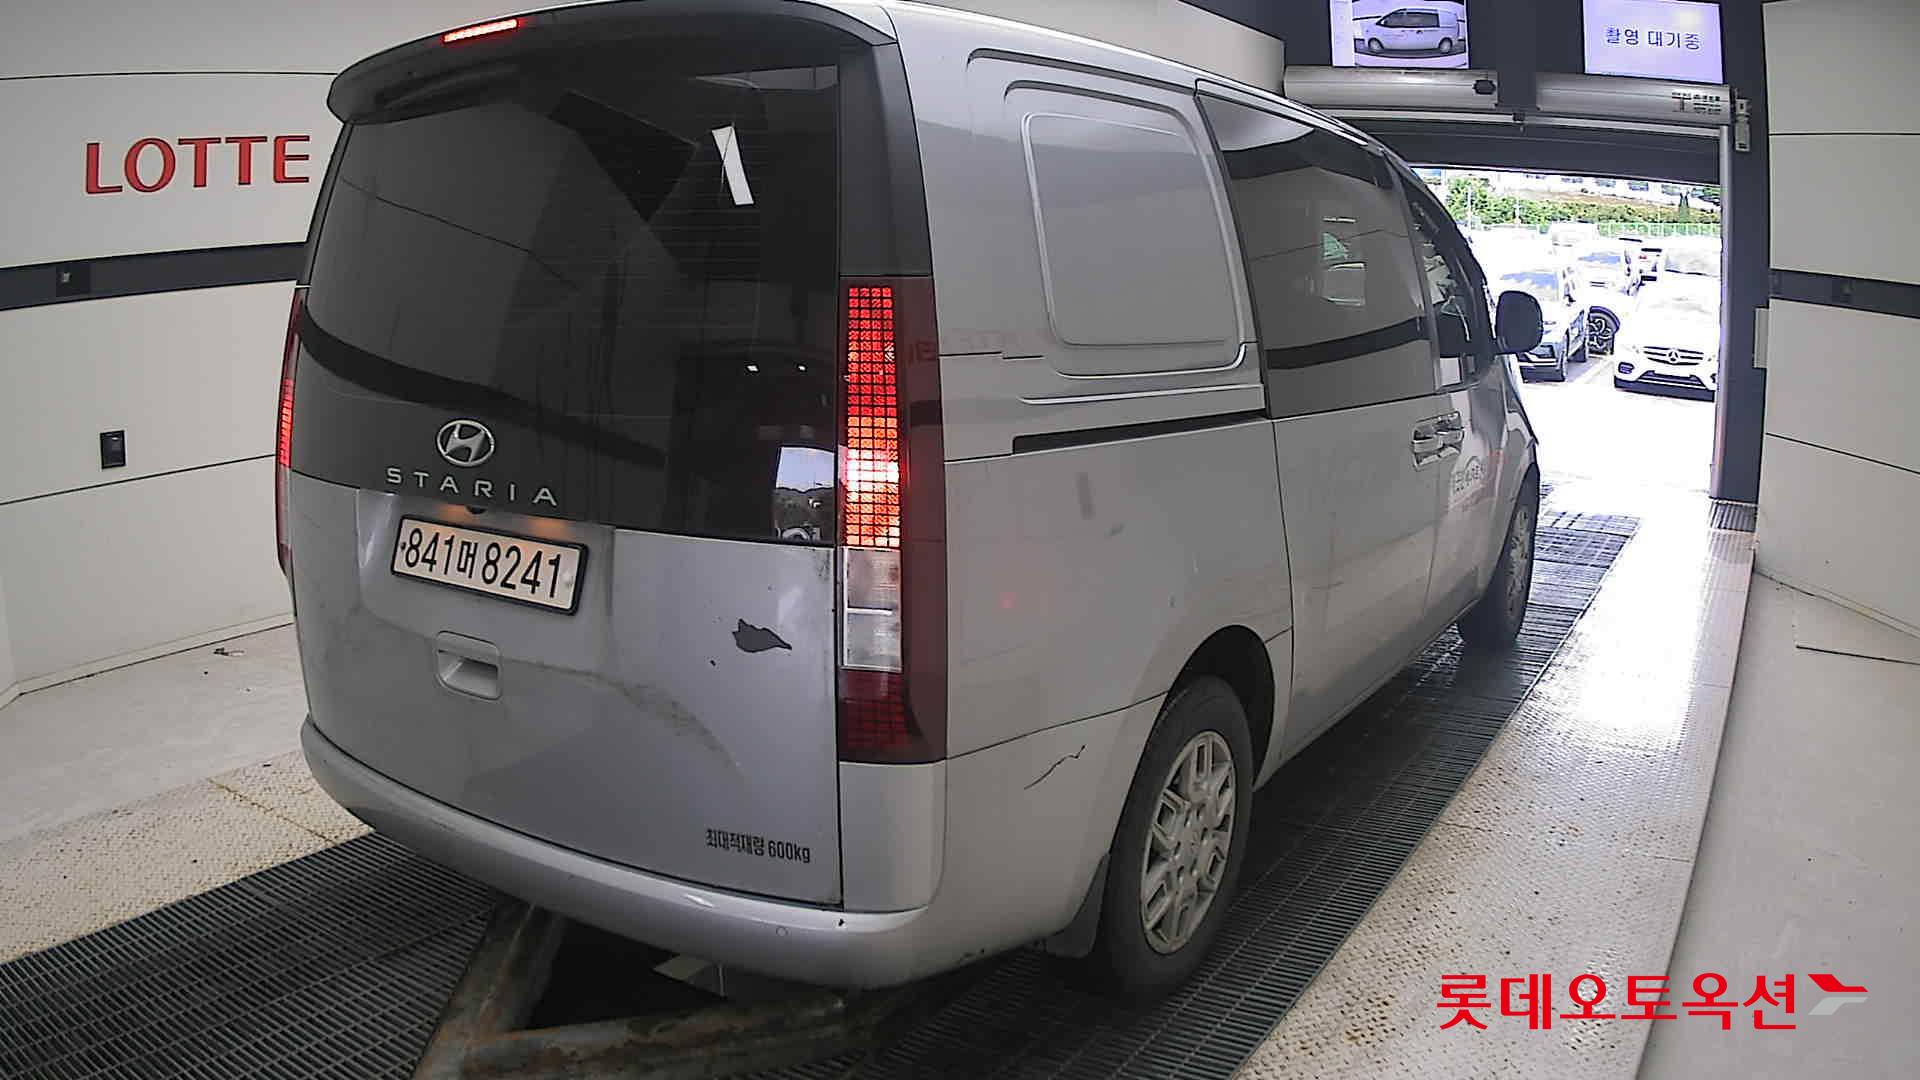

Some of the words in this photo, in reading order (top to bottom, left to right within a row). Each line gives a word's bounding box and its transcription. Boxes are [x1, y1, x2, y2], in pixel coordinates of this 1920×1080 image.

[1606, 27, 1639, 46] 촬영
[1648, 30, 1700, 50] 대기중
[85, 135, 310, 194] LOTTE
[385, 467, 557, 506] STARIA
[404, 528, 562, 598] 841머8241
[706, 829, 765, 856] 최대적재량
[768, 840, 811, 864] 600kg
